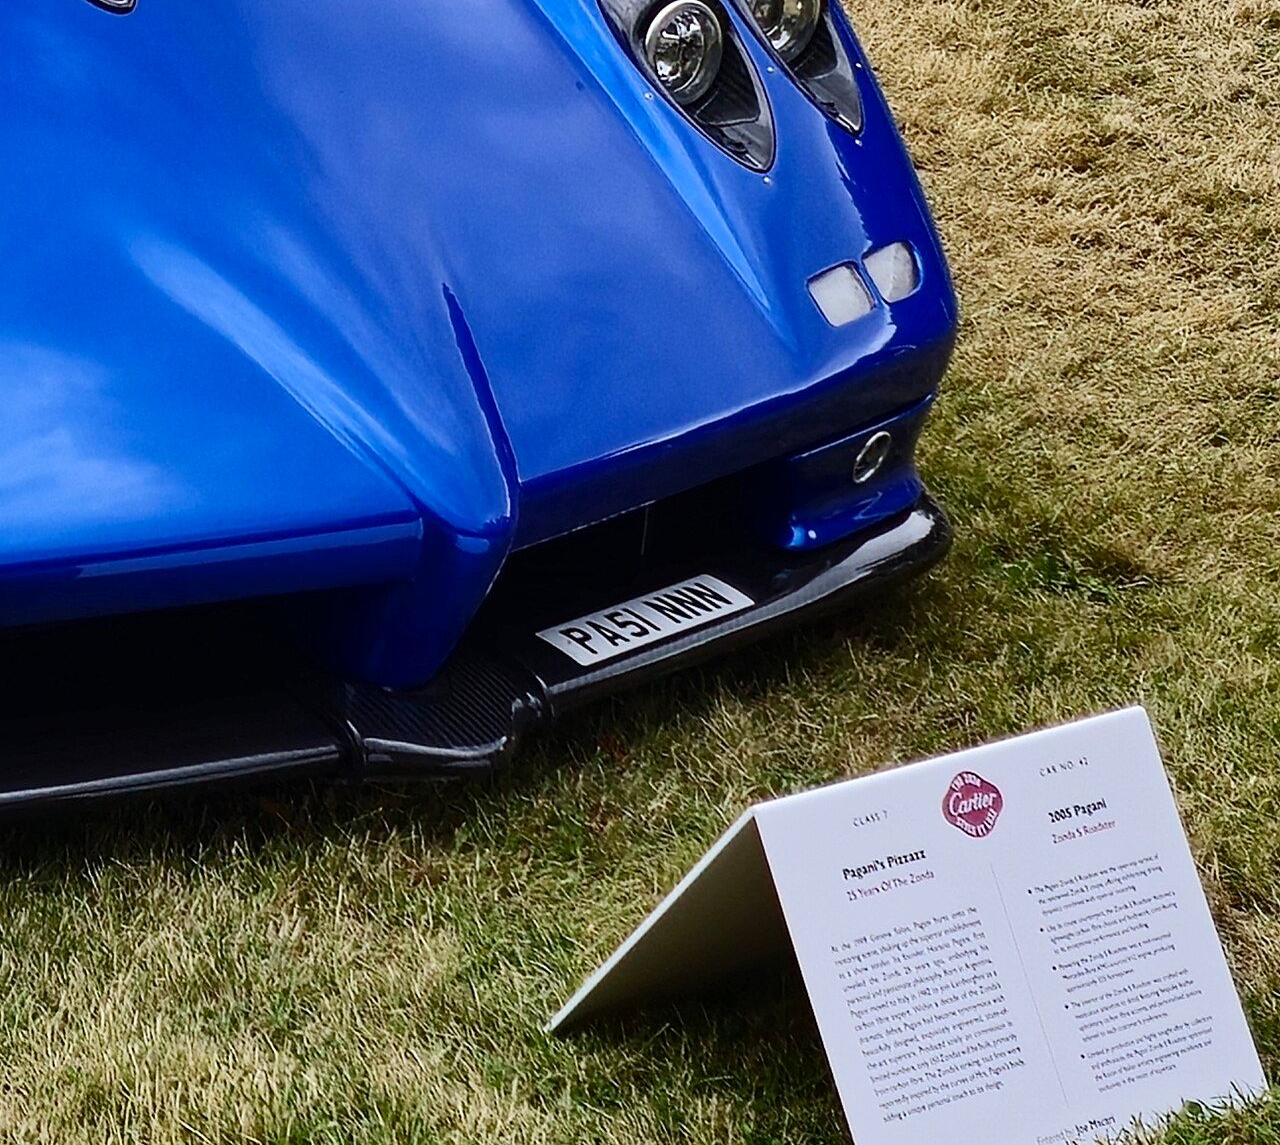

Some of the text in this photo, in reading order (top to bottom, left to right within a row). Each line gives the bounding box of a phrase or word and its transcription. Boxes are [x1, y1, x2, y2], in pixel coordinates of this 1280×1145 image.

[643, 581, 733, 625] NNN
[949, 791, 997, 816] Cartier
[1072, 797, 1107, 816] Pagani
[841, 859, 885, 880] Pagani's
